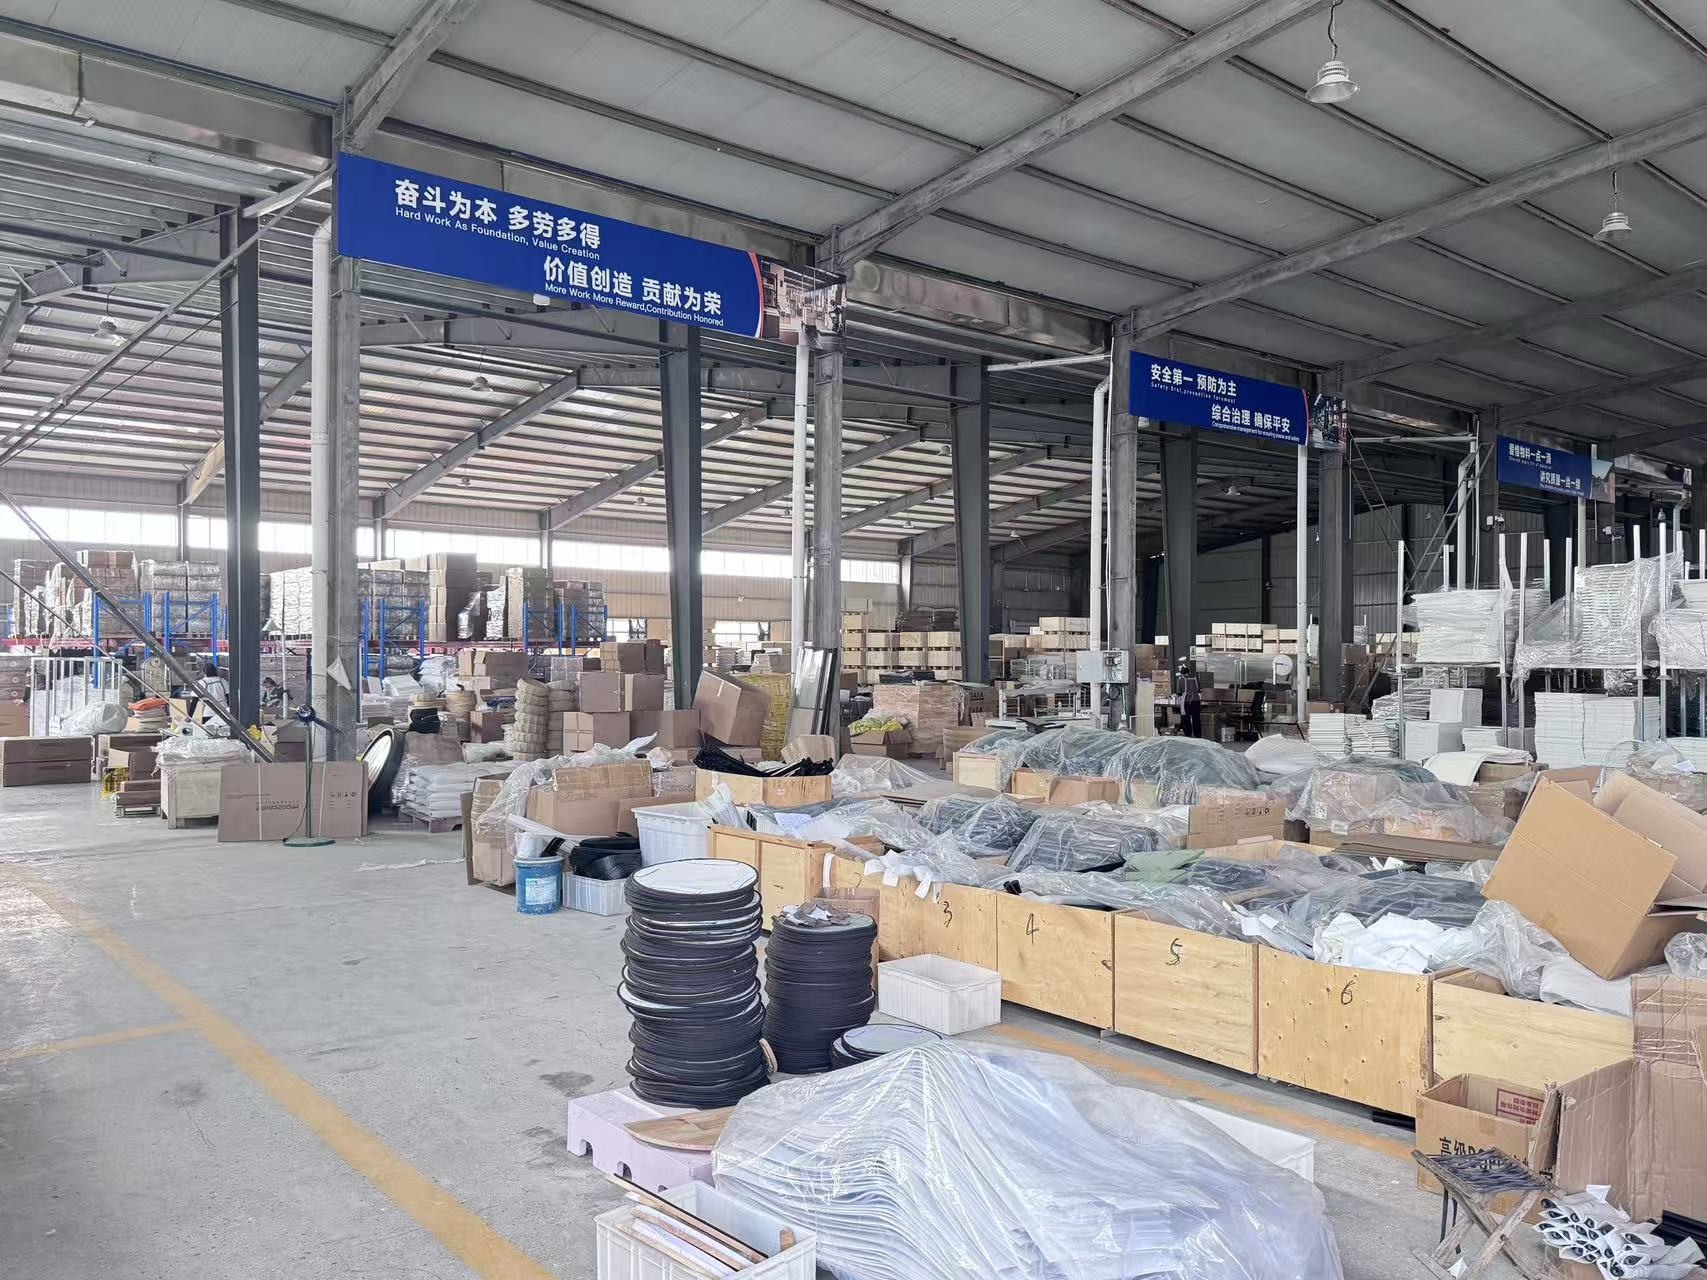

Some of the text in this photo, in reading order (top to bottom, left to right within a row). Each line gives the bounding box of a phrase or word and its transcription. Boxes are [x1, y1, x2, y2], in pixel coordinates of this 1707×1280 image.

[395, 179, 601, 249] 奋斗为本 多劳多得
[395, 206, 600, 261] Hard Work As Foundation, Value Creation
[543, 255, 722, 316] 价值创造 贡献为荣
[545, 283, 567, 295] More
[569, 287, 591, 300] Work
[592, 294, 614, 305] More
[694, 313, 724, 327] Honored
[1150, 363, 1237, 397] 安全第一 预防为主
[1150, 381, 1168, 391] Safety
[1211, 403, 1291, 433] 综合治理 确保平安
[943, 900, 953, 928] 3
[1025, 912, 1040, 945] 4
[1165, 937, 1184, 966] 5
[1340, 980, 1356, 1005] 6
